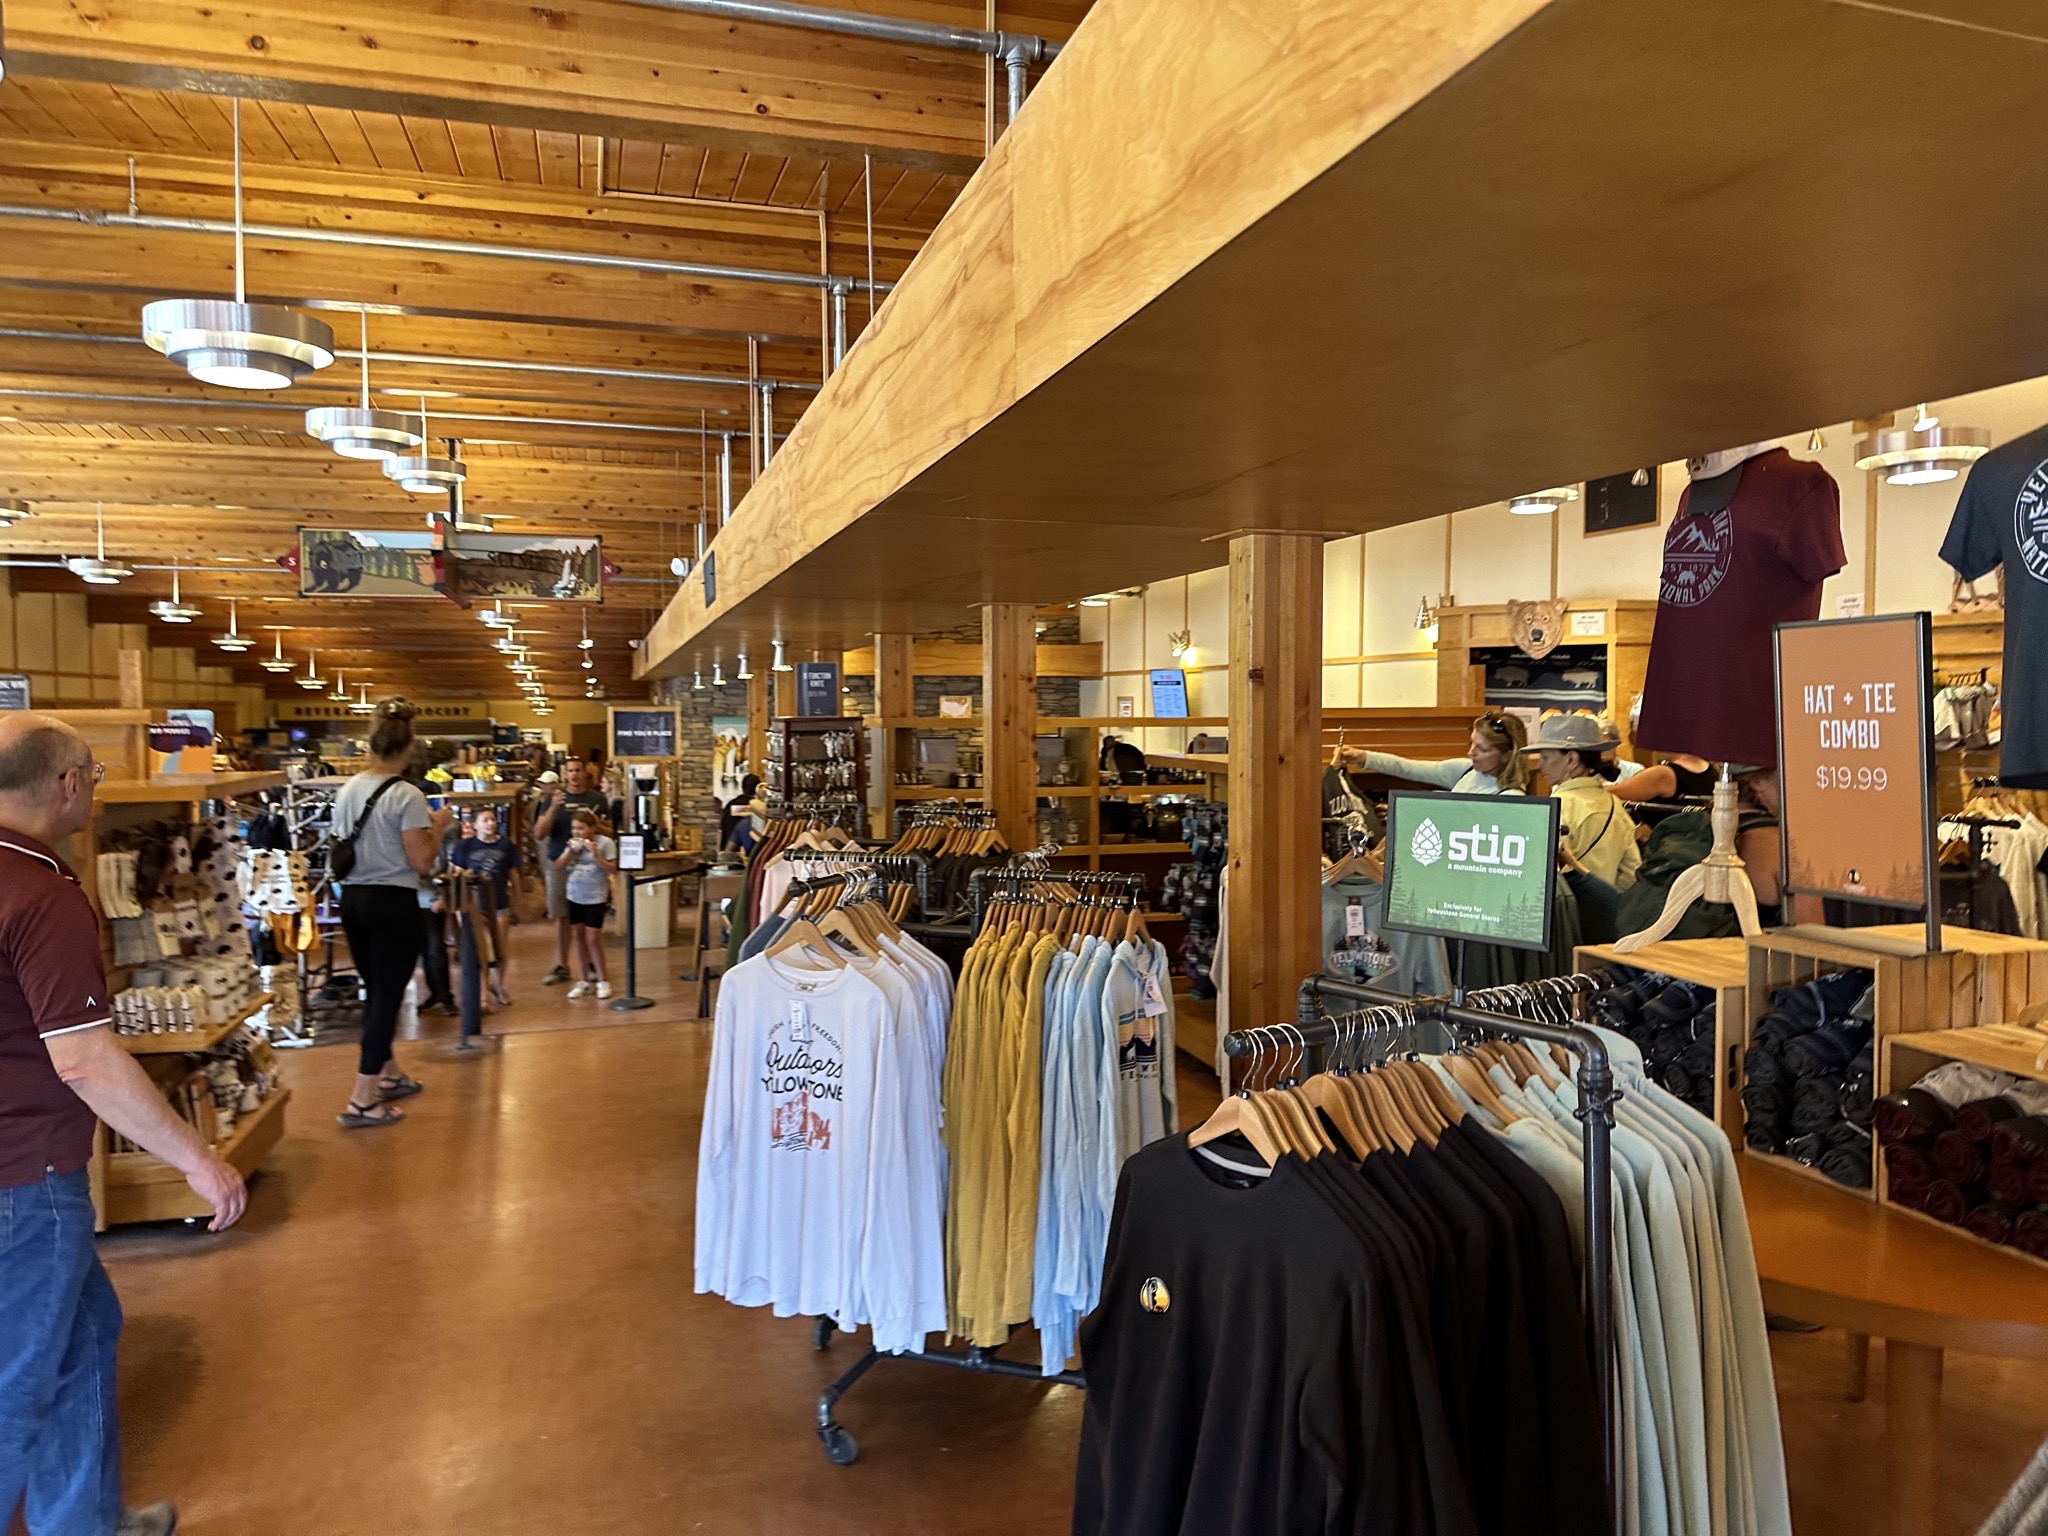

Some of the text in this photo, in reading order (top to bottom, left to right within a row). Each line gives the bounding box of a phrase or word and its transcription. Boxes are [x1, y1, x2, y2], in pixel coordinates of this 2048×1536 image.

[1698, 565, 1724, 598] PARK
[1804, 682, 1896, 714] HAT + TEE
[1820, 719, 1880, 749] COMBO
[1816, 764, 1887, 791] $19.99
[1447, 823, 1527, 867] stio
[1453, 864, 1487, 873] mountain
[1488, 867, 1523, 878] company
[1427, 907, 1500, 923] Yellowstone General Stores
[1443, 902, 1482, 913] Exclusively for
